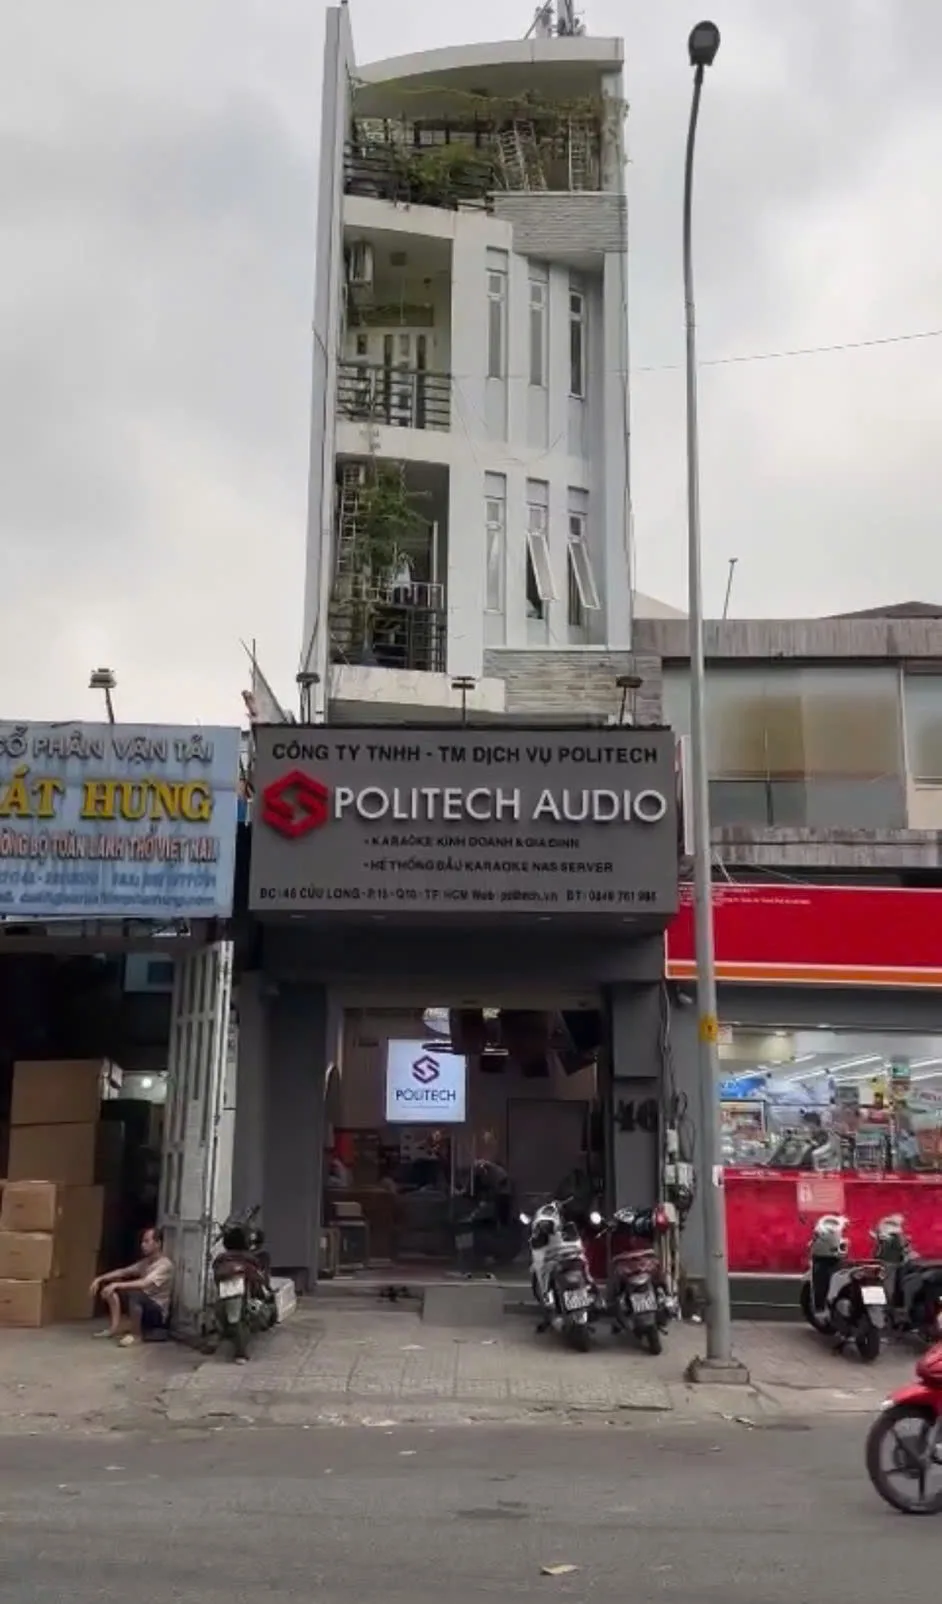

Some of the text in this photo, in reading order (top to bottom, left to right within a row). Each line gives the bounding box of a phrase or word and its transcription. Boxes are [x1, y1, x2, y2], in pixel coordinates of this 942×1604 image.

[112, 736, 168, 764] VẬN
[272, 740, 329, 760] CÔNG
[335, 744, 360, 760] TY
[367, 744, 420, 762] TNHH
[438, 746, 466, 763] TM
[473, 746, 520, 765] DỊCH
[526, 746, 552, 767] VỤ
[558, 747, 657, 763] POLITECH
[335, 786, 667, 822] POLITECH AUDIO
[468, 836, 513, 848] DOANH
[560, 861, 614, 874] SERVER
[395, 1088, 457, 1101] POLITECH
